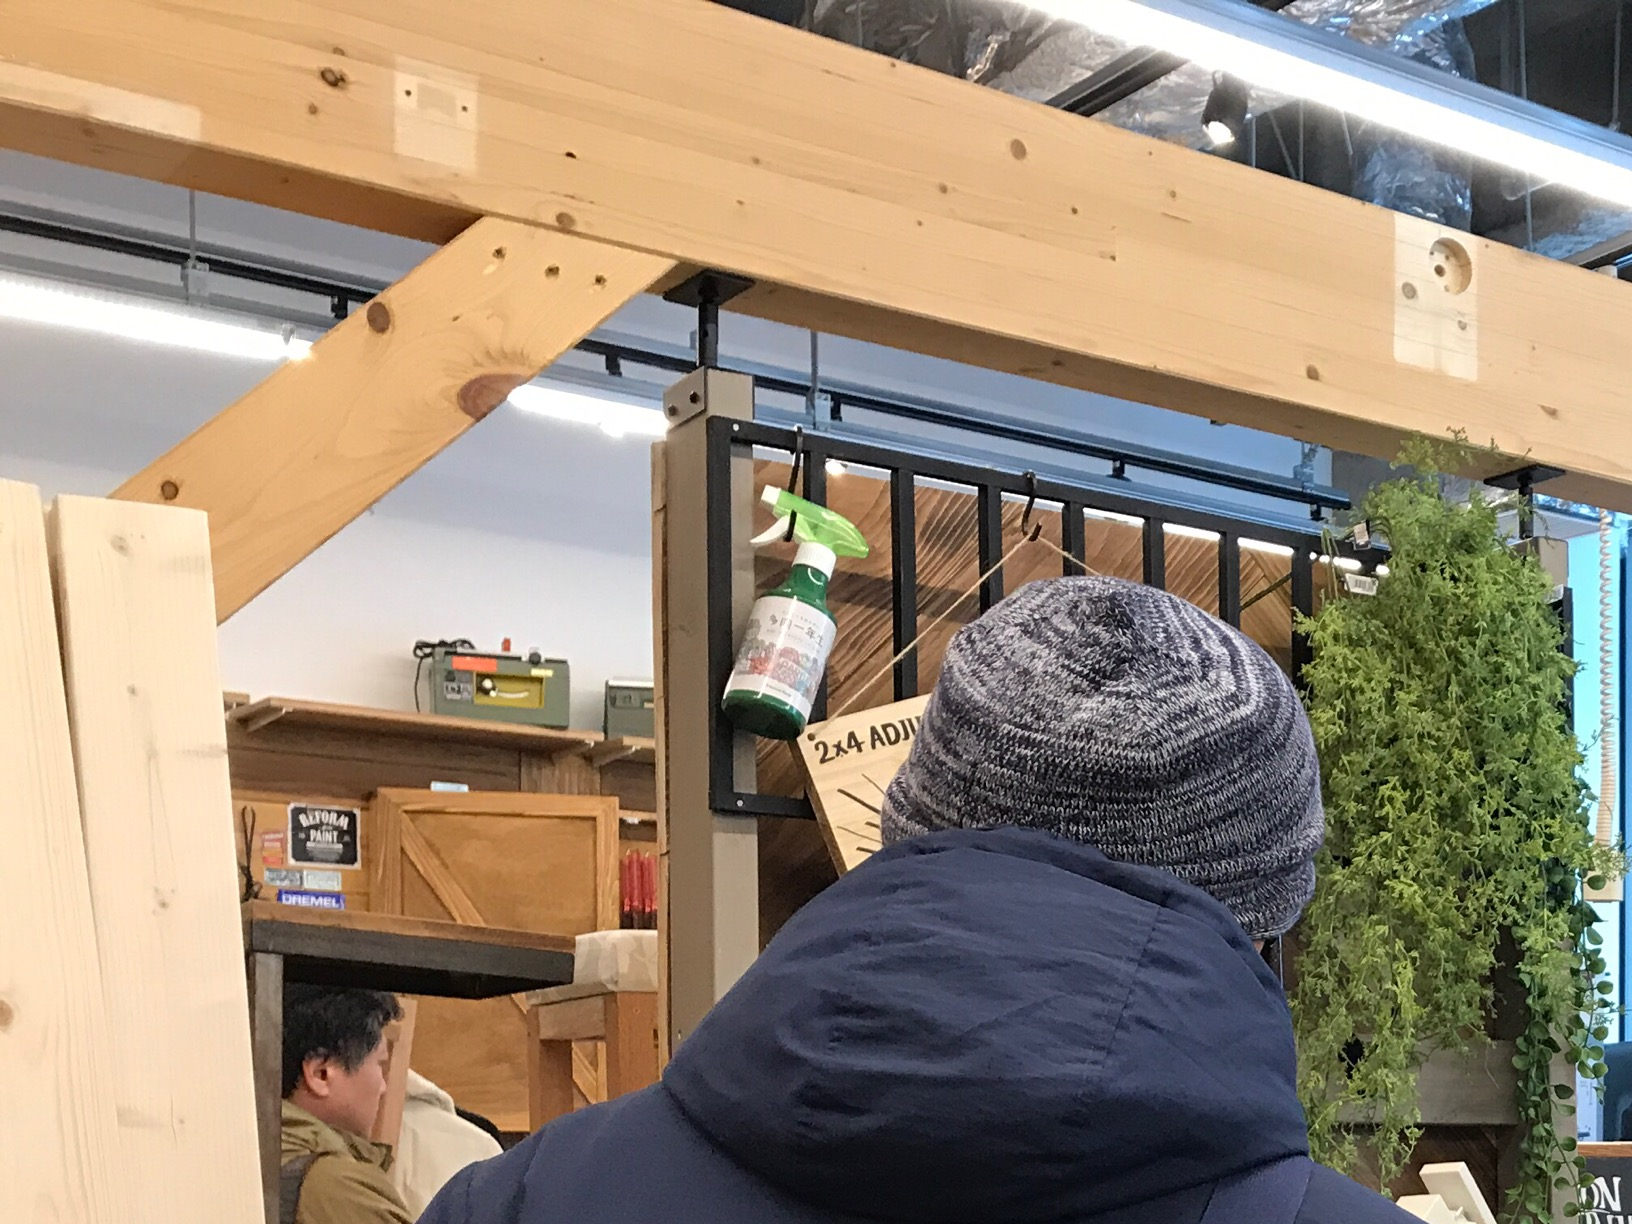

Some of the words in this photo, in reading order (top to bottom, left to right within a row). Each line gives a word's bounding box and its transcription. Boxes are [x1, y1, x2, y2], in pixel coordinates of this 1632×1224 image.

[814, 730, 865, 764] 2x4
[309, 828, 339, 843] PAINT
[281, 893, 340, 907] DREMEL
